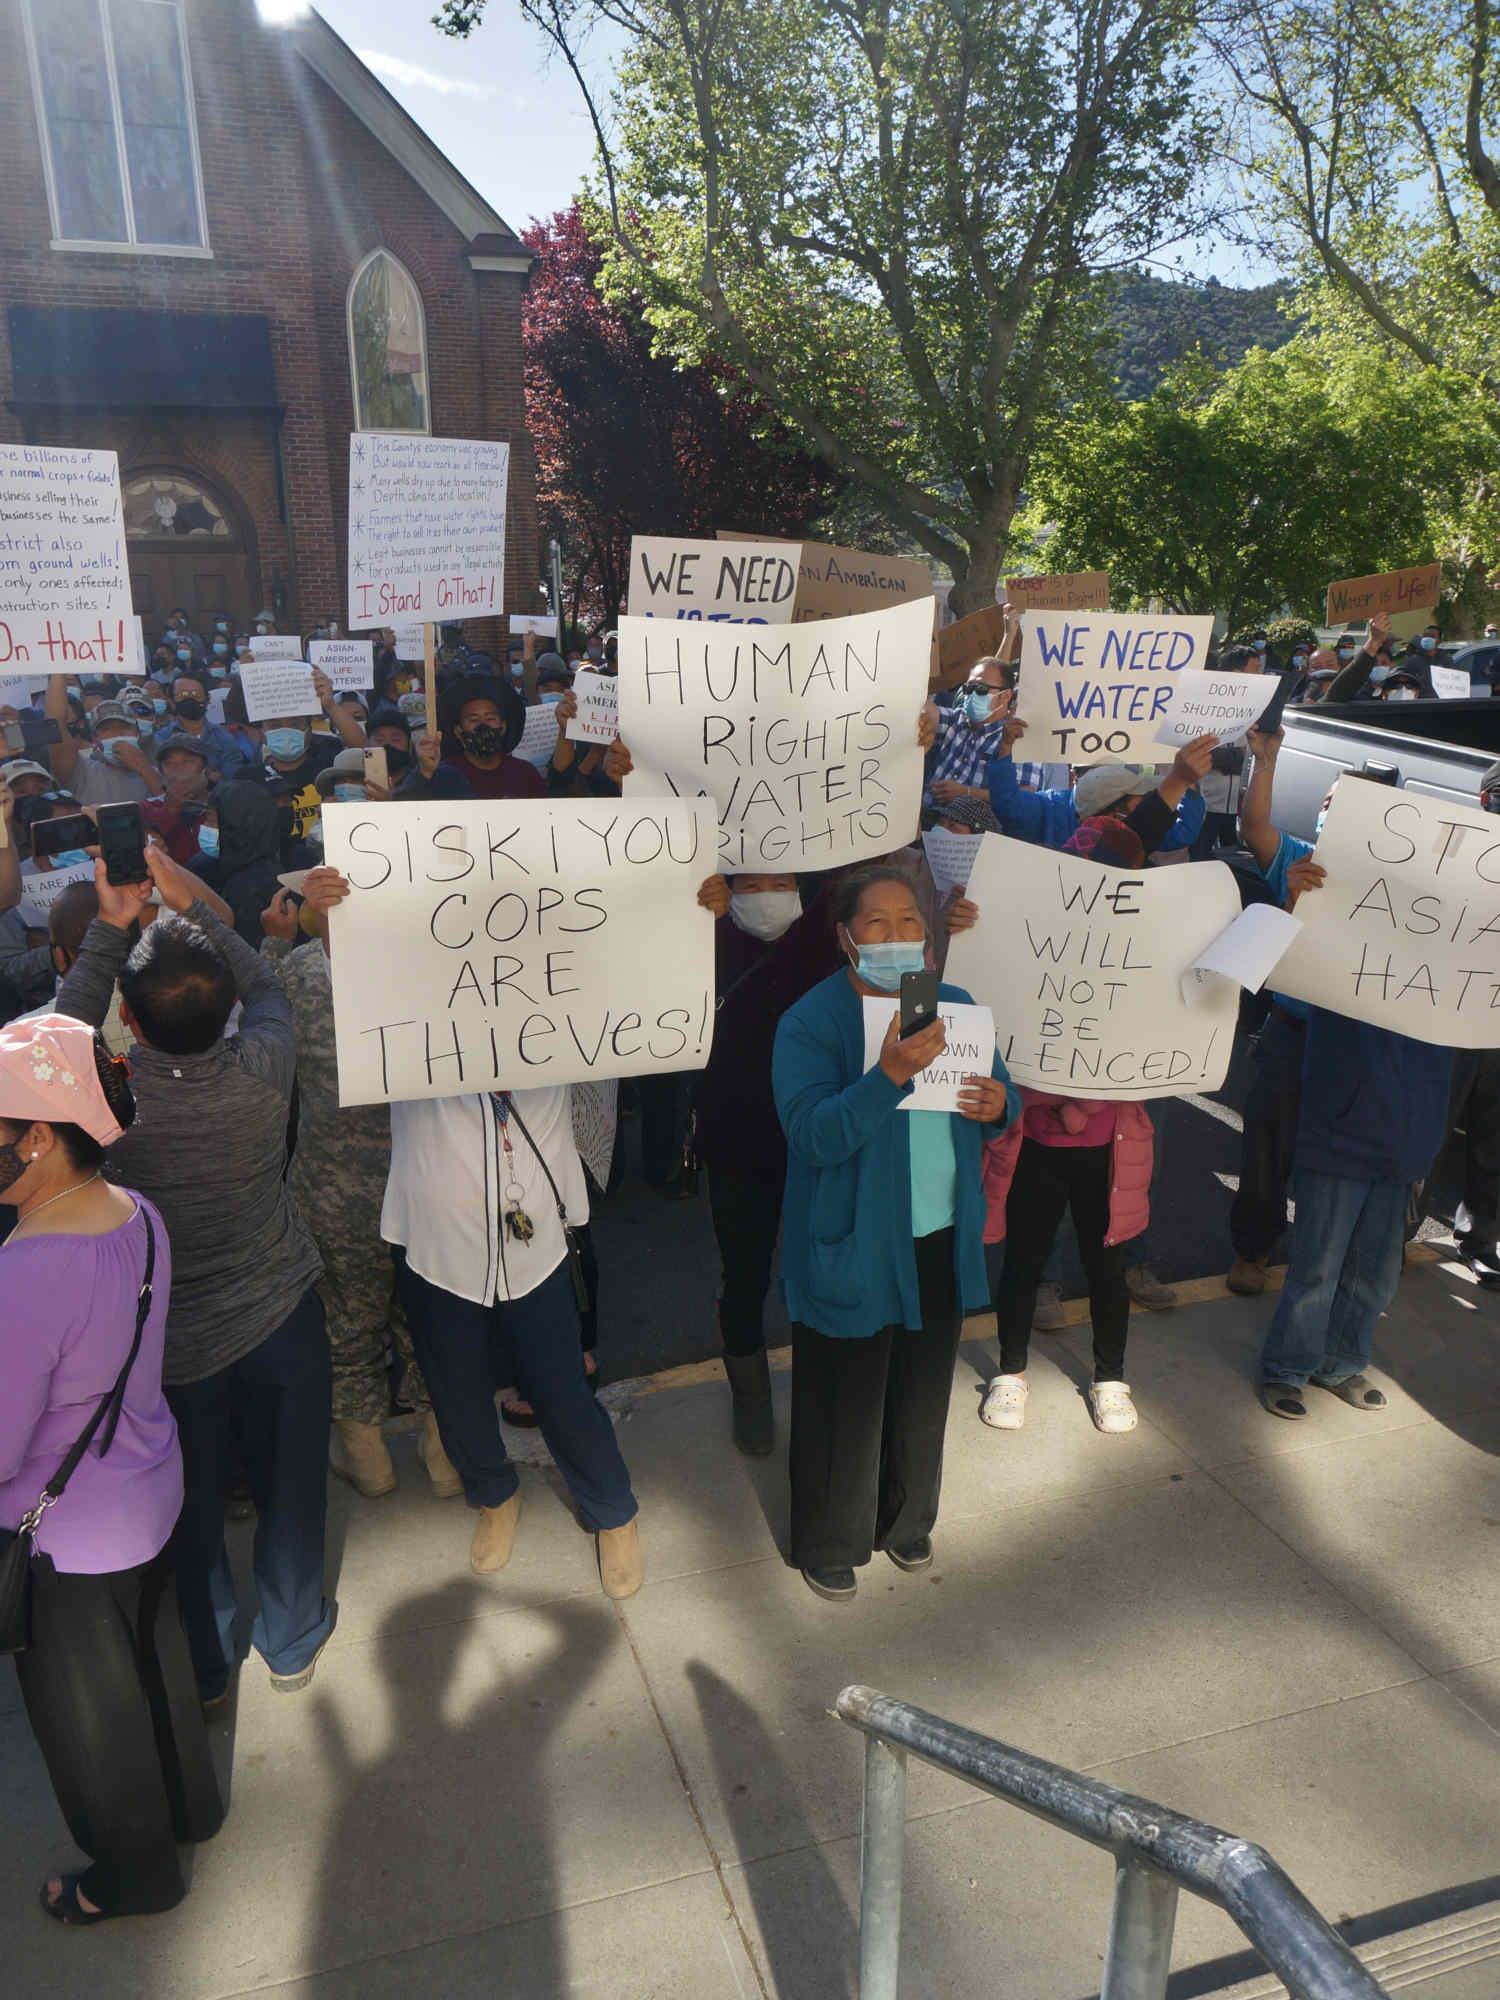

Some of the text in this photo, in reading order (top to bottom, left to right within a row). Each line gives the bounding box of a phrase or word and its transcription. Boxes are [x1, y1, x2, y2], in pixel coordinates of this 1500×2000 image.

[24, 449, 77, 464] billions
[34, 491, 67, 506] selling
[70, 493, 99, 508] their
[58, 511, 77, 524] the
[51, 535, 82, 551] also
[29, 554, 73, 574] ground
[80, 540, 120, 569] wells!
[4, 575, 32, 595] only
[39, 579, 69, 589] ones
[641, 553, 795, 603] WE NEED
[0, 598, 60, 612] struction
[356, 575, 495, 619] I Stand On That!
[38, 619, 124, 663] that!
[1037, 623, 1090, 667] WE
[1100, 630, 1195, 672] NEED
[319, 655, 366, 664] AMERICAN
[333, 665, 353, 674] LIFE
[645, 630, 881, 705] HUMAN
[335, 677, 365, 685] TTERS!
[1208, 683, 1248, 697] DON'T
[1055, 681, 1174, 722] WATER
[1181, 702, 1256, 719] SHUTDOWN
[1051, 728, 1131, 755] TOO
[1174, 723, 1203, 736] OUR
[40, 878, 64, 890] ARE
[1058, 863, 1144, 914] WE
[430, 888, 607, 949] COPS
[448, 950, 581, 1008] ARE
[1038, 972, 1128, 1010] NOT
[1039, 1008, 1100, 1041] BE
[1004, 1026, 1218, 1083] LENCED!
